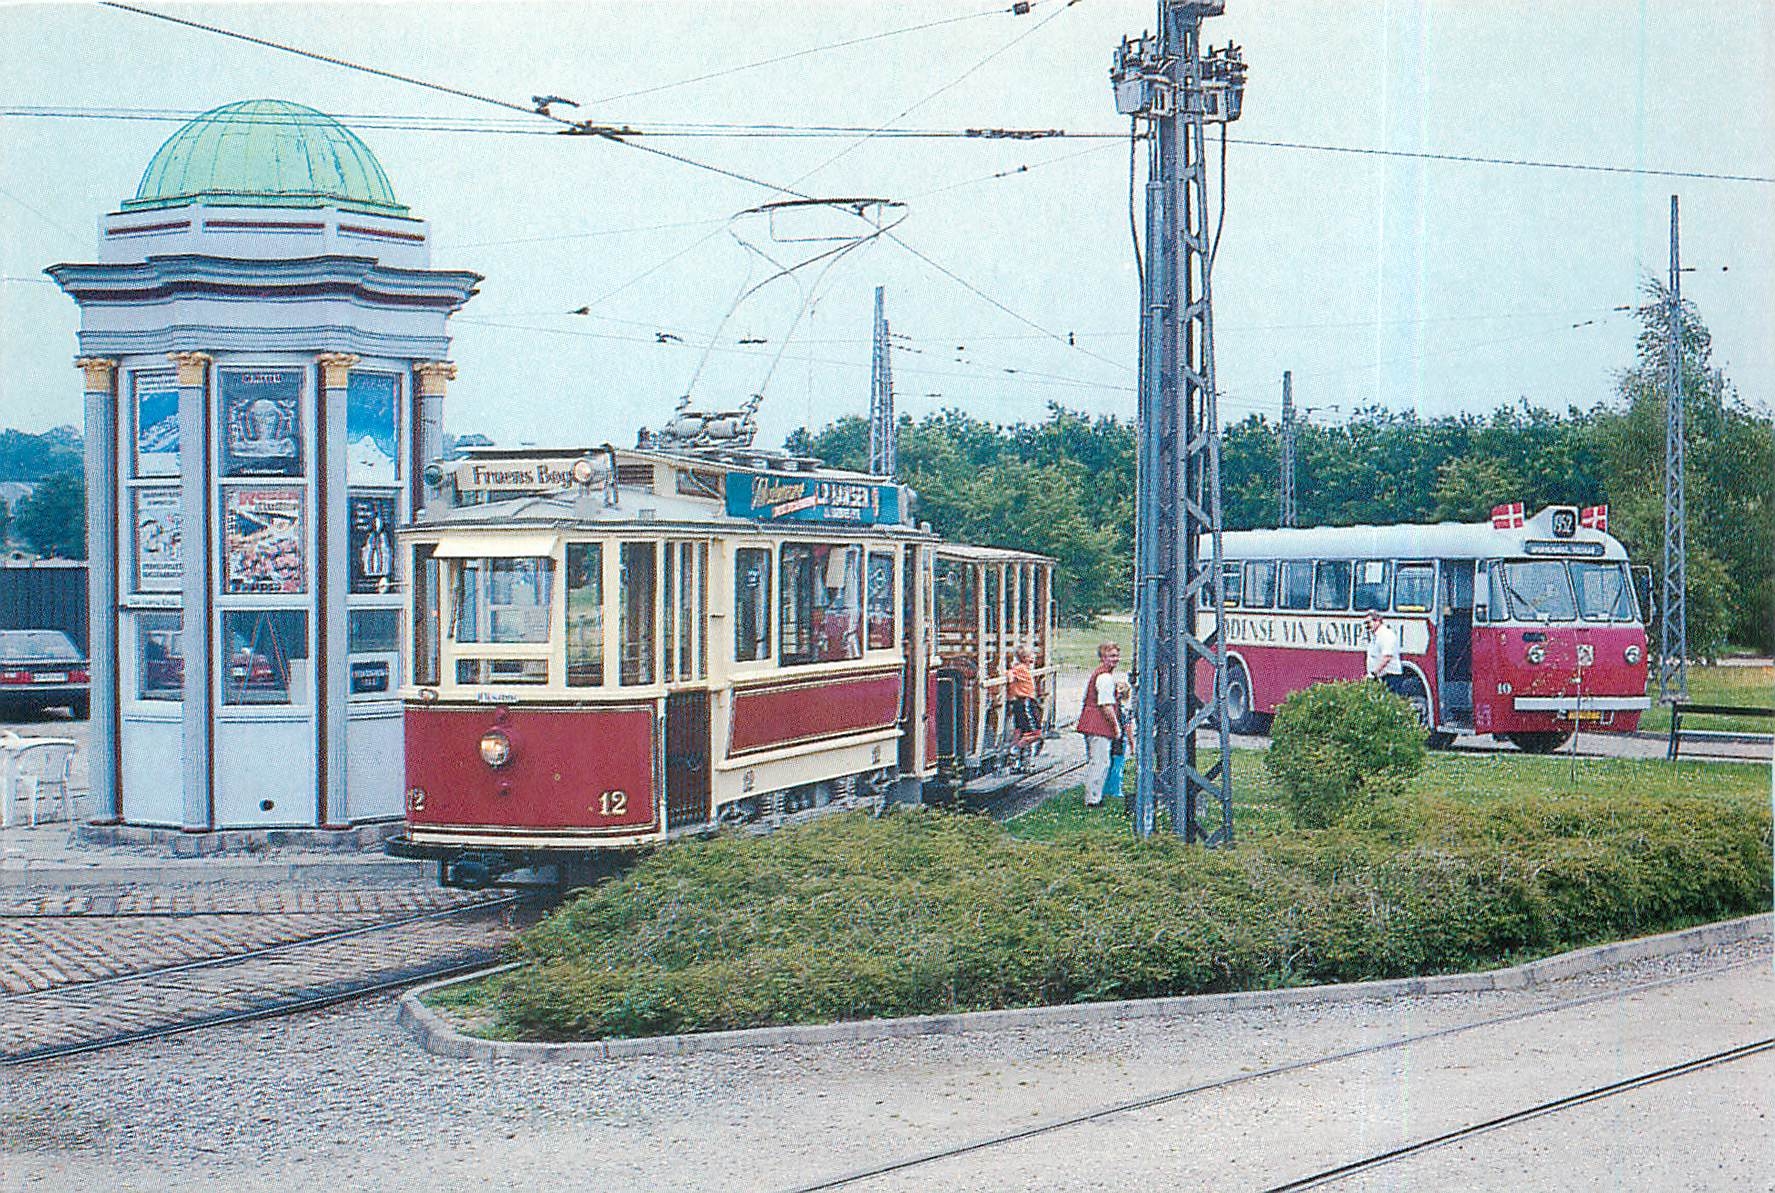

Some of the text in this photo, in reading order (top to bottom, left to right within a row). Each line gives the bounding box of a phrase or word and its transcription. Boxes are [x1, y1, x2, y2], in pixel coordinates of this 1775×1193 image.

[472, 465, 534, 485] Fruens
[1316, 621, 1404, 648] KOMPAI
[1496, 681, 1513, 695] 10
[598, 790, 628, 816] 12
